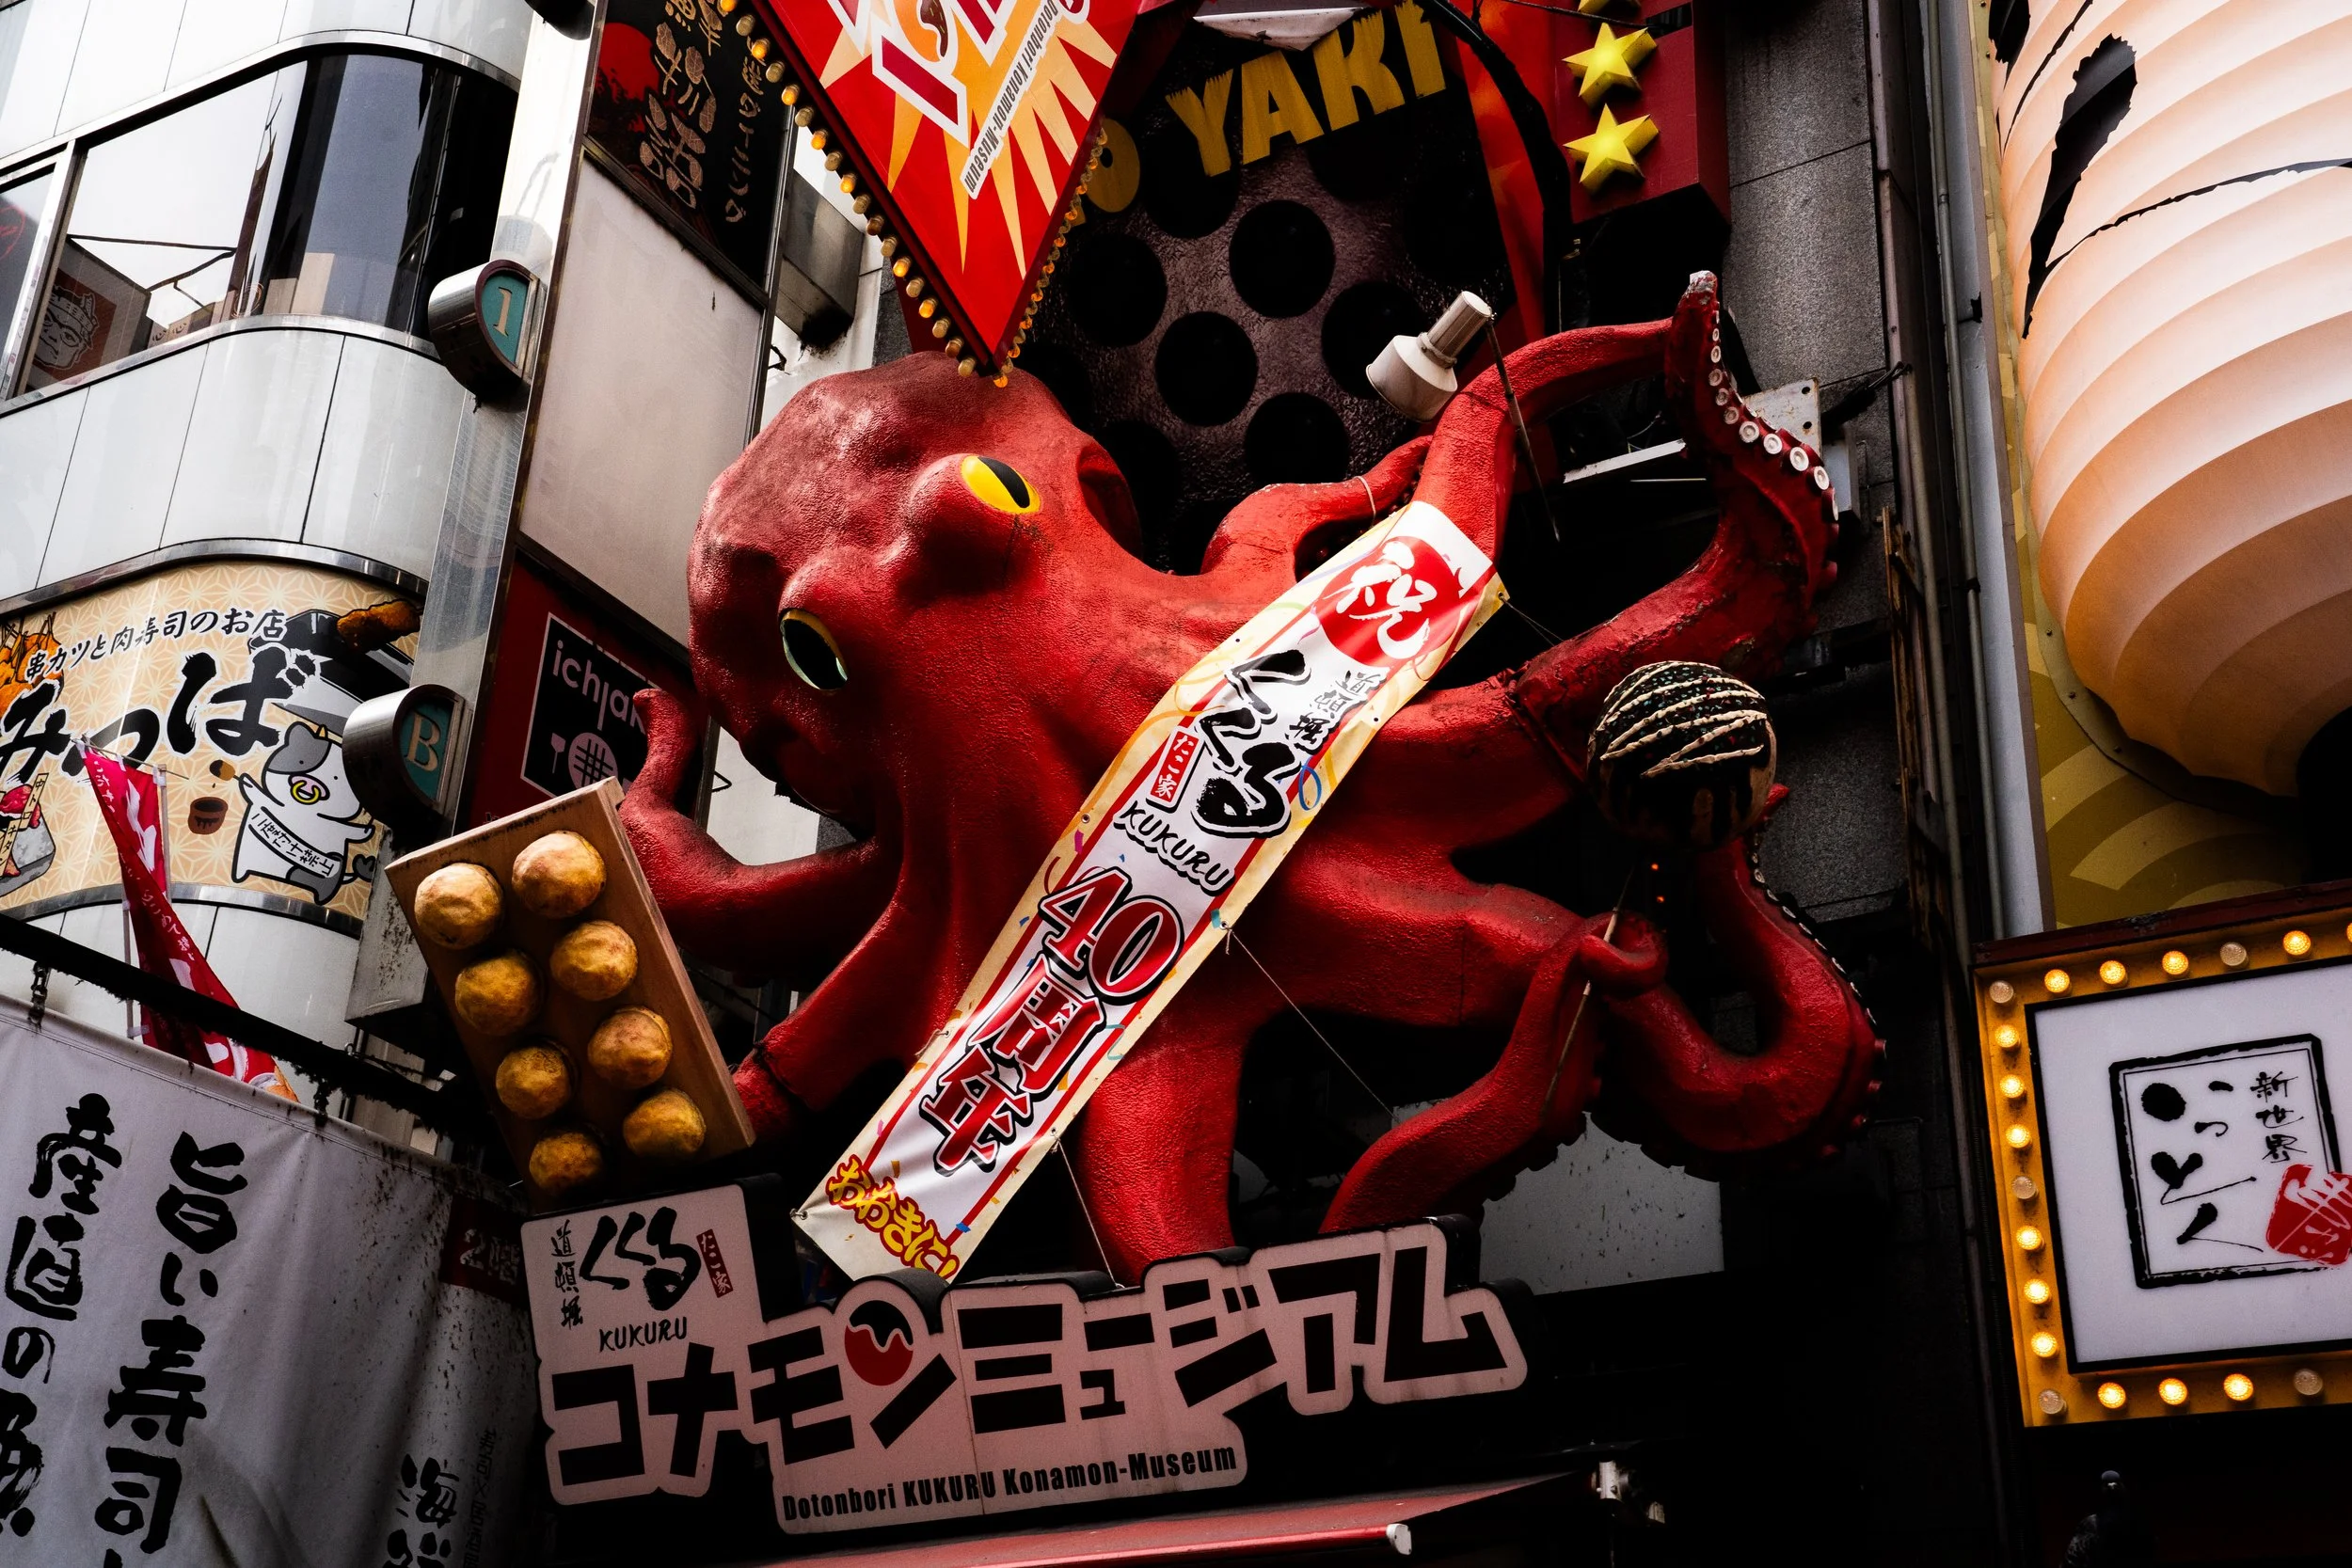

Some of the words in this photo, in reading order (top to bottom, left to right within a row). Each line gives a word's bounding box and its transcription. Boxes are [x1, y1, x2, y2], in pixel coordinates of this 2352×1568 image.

[963, 61, 1028, 194] Konamon-Museum
[1165, 0, 1446, 177] YAKI
[26, 608, 287, 679] 串カツと肉寿司のお店
[1319, 541, 1438, 659] 祝
[405, 710, 442, 772] B
[1195, 649, 1308, 836] くくる
[1288, 669, 1381, 745] 道頓堀
[1153, 732, 1197, 800] たこ家
[1119, 800, 1231, 884] KUKURU
[2249, 1070, 2309, 1164] 新世界
[550, 1219, 584, 1330] 道頓堀
[579, 1206, 702, 1312] くくる
[699, 1231, 733, 1296] たこ家
[551, 1245, 1508, 1486] コナモンミュージアム
[598, 1316, 688, 1353] KUKURU
[782, 1483, 898, 1522] Dotonbori
[903, 1467, 997, 1507] KUKURU
[1003, 1446, 1237, 1496] Konamon-Museum
